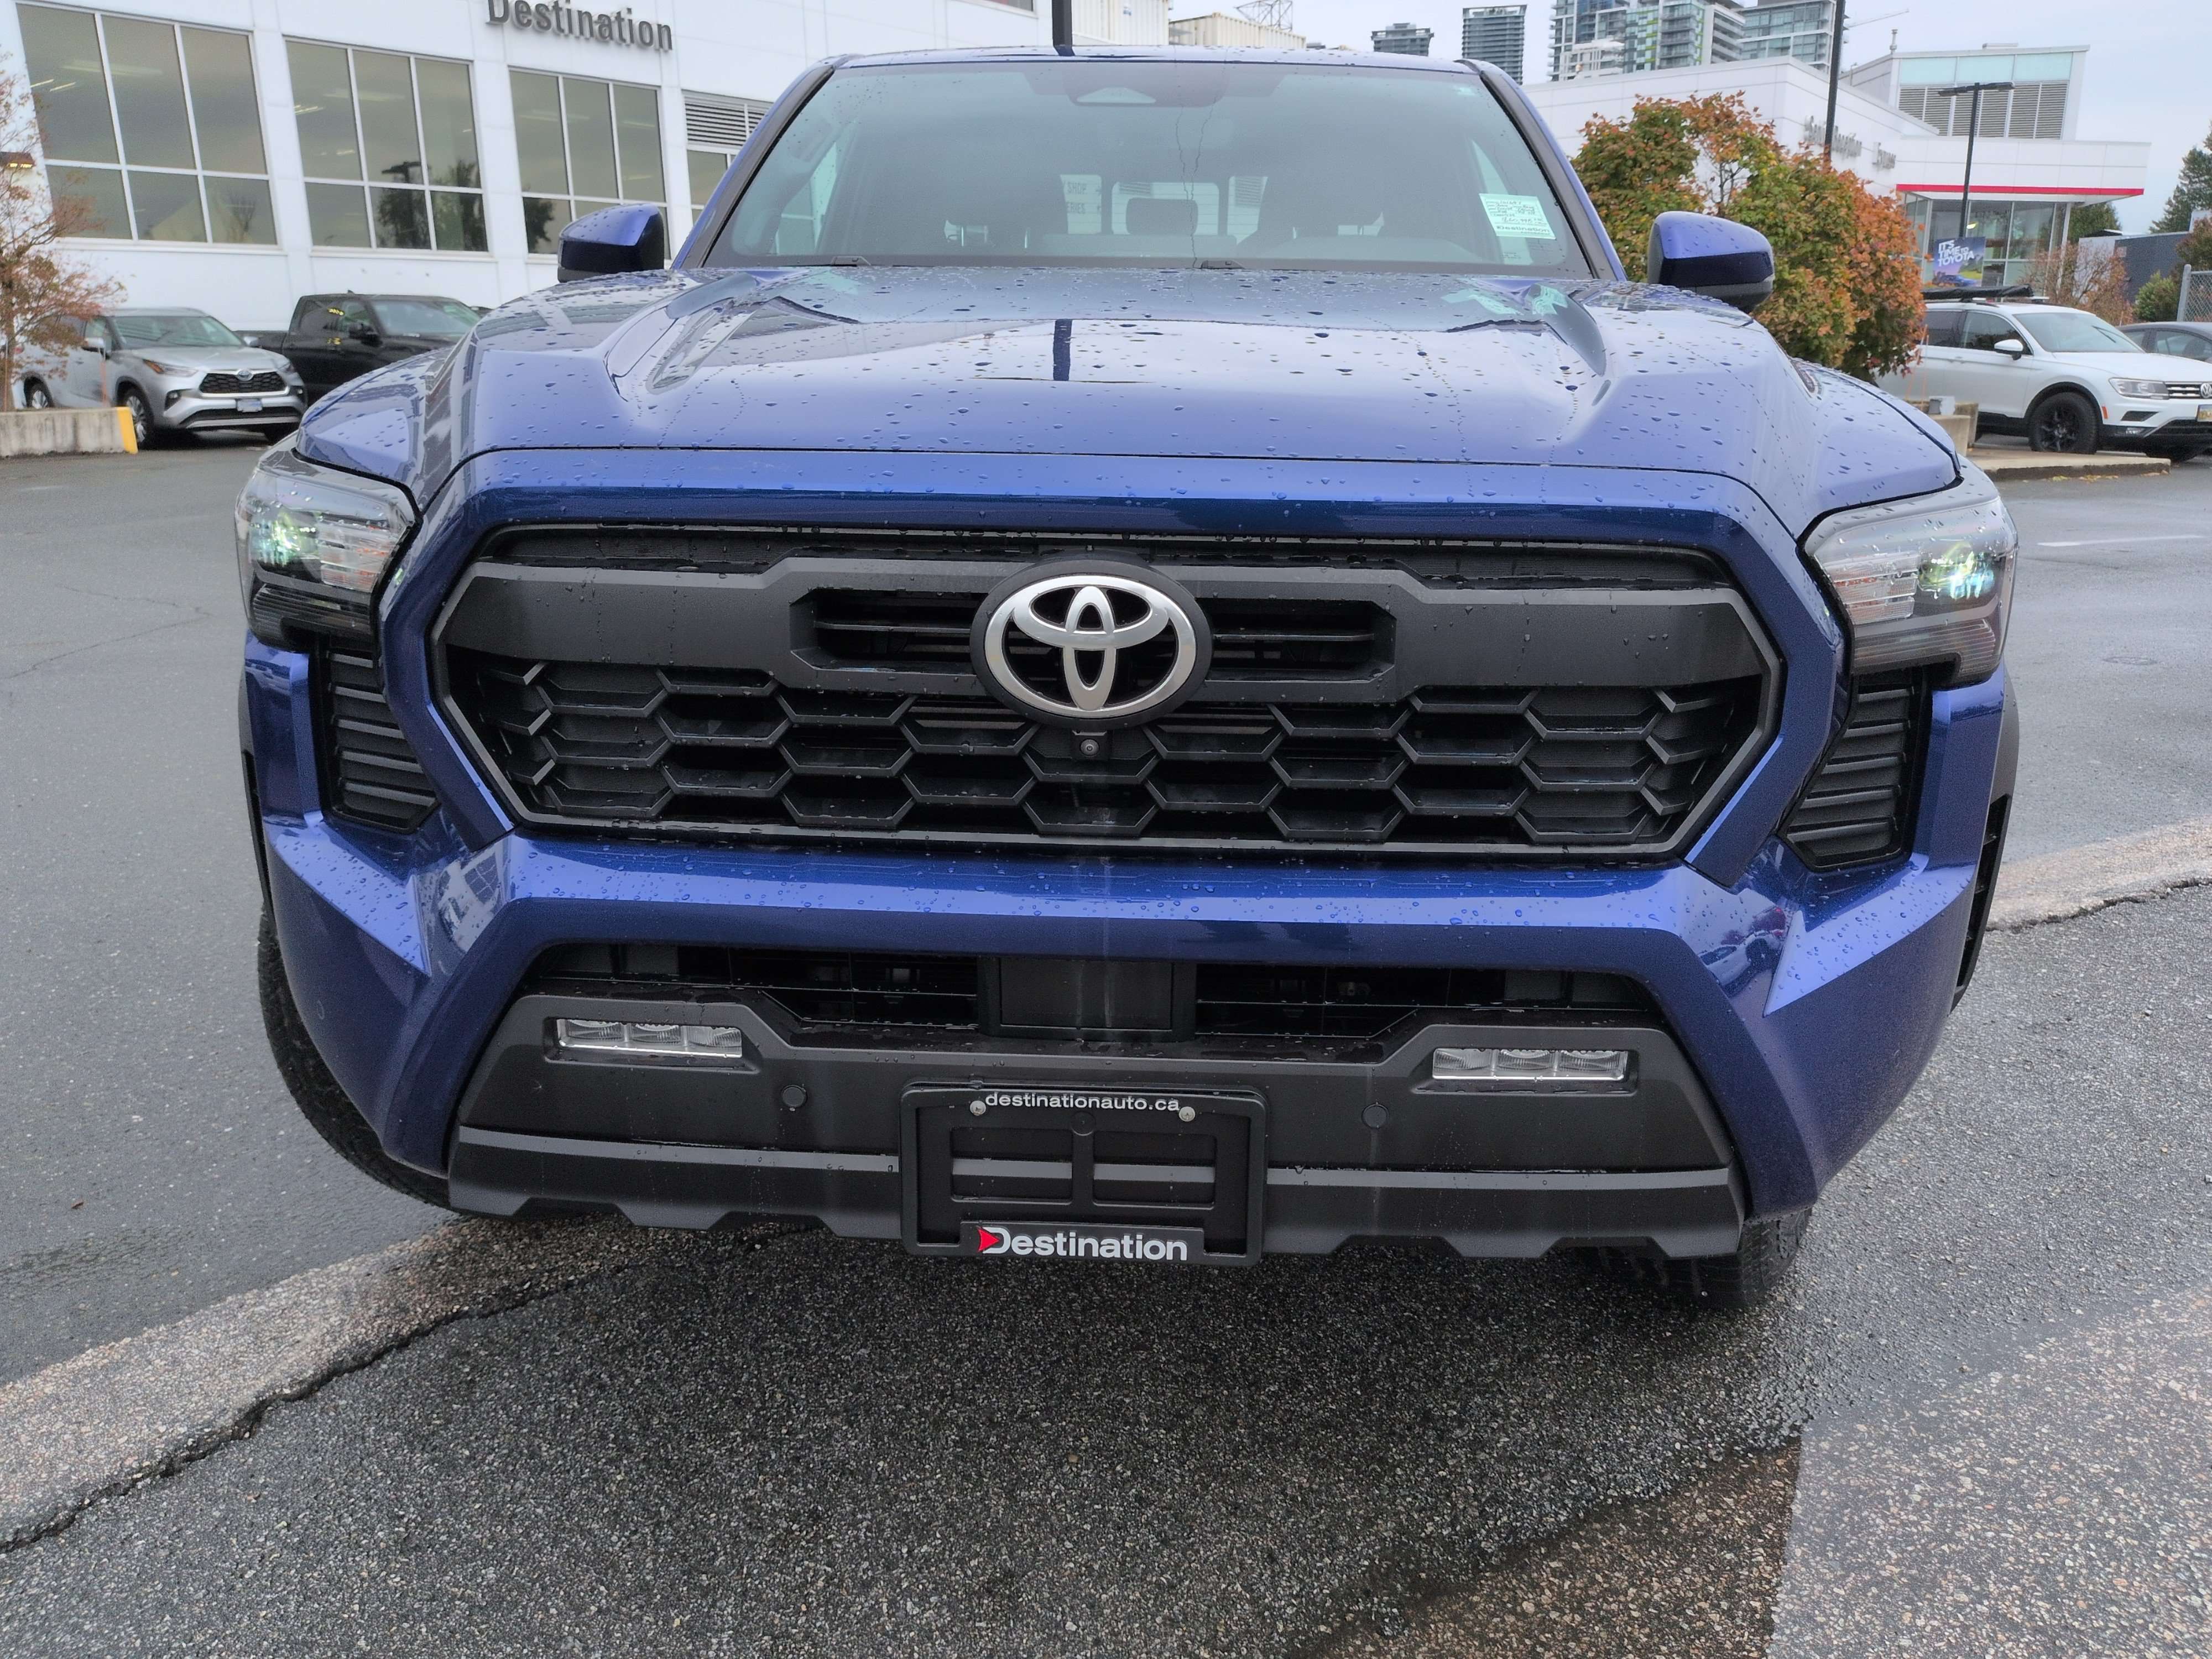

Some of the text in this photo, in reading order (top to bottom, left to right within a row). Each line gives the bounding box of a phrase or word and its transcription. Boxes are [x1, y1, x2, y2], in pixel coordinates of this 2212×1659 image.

[487, 0, 673, 51] Destination
[1938, 239, 1955, 254] IT'S
[1938, 246, 1961, 259] TIME
[1938, 251, 1974, 267] TOYOTA
[985, 1092, 1180, 1112] destinationauto.ca
[978, 1226, 1188, 1261] Destination
